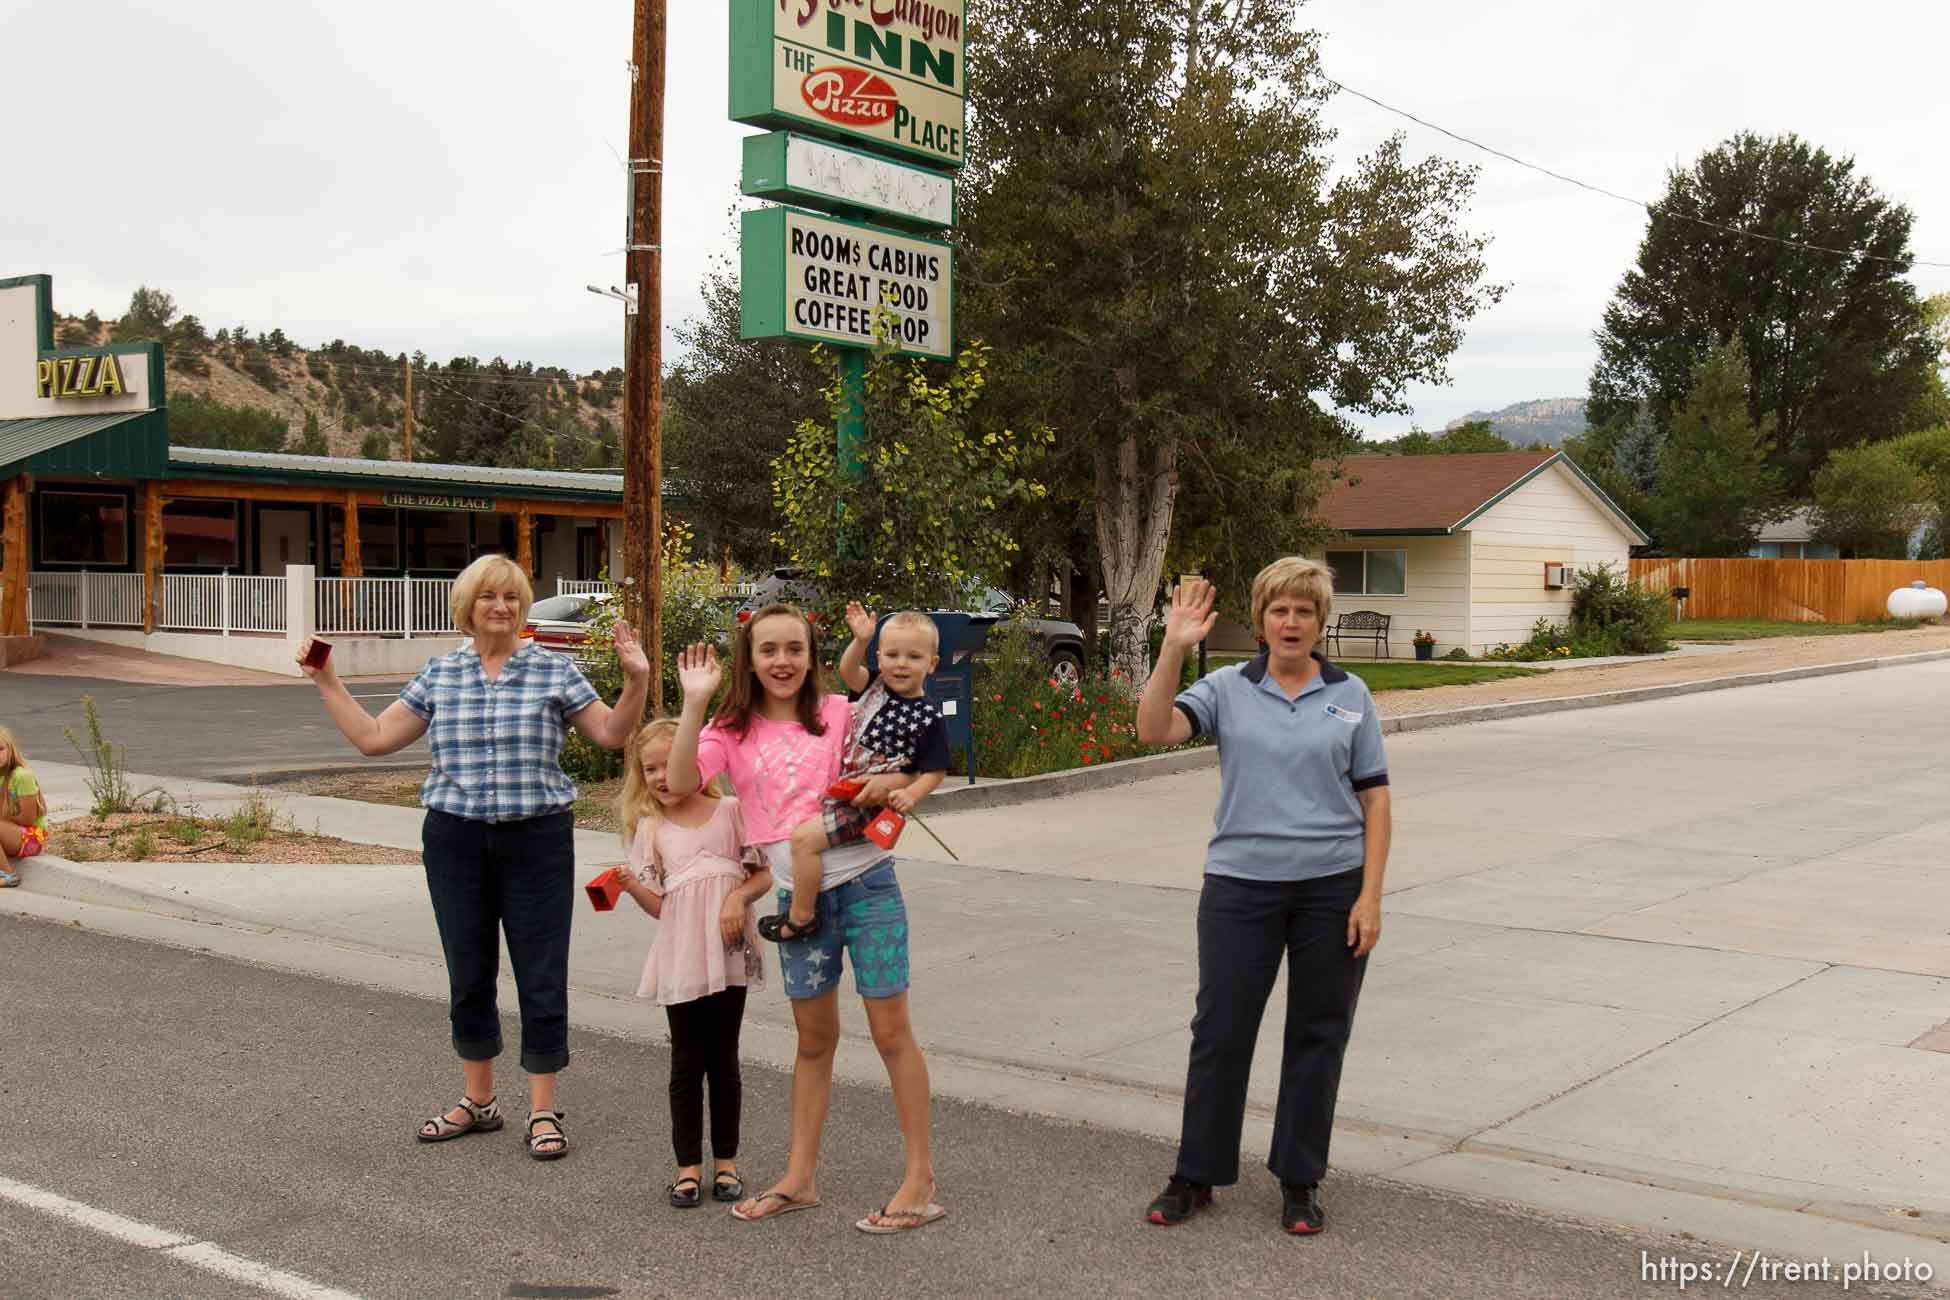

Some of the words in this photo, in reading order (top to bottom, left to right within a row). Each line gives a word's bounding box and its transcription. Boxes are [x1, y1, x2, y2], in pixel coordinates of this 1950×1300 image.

[826, 10, 955, 88] INN
[783, 46, 815, 74] THE
[805, 71, 888, 117] Pizza
[893, 105, 960, 156] PLACE
[868, 244, 939, 282] CABINS
[804, 265, 871, 301] GREAT
[879, 279, 928, 312] FOOD
[795, 298, 871, 336] COFFEE
[37, 352, 122, 399] PIZZA
[391, 493, 416, 505] THE
[418, 495, 450, 507] PIZZA
[452, 497, 489, 509] PLACE
